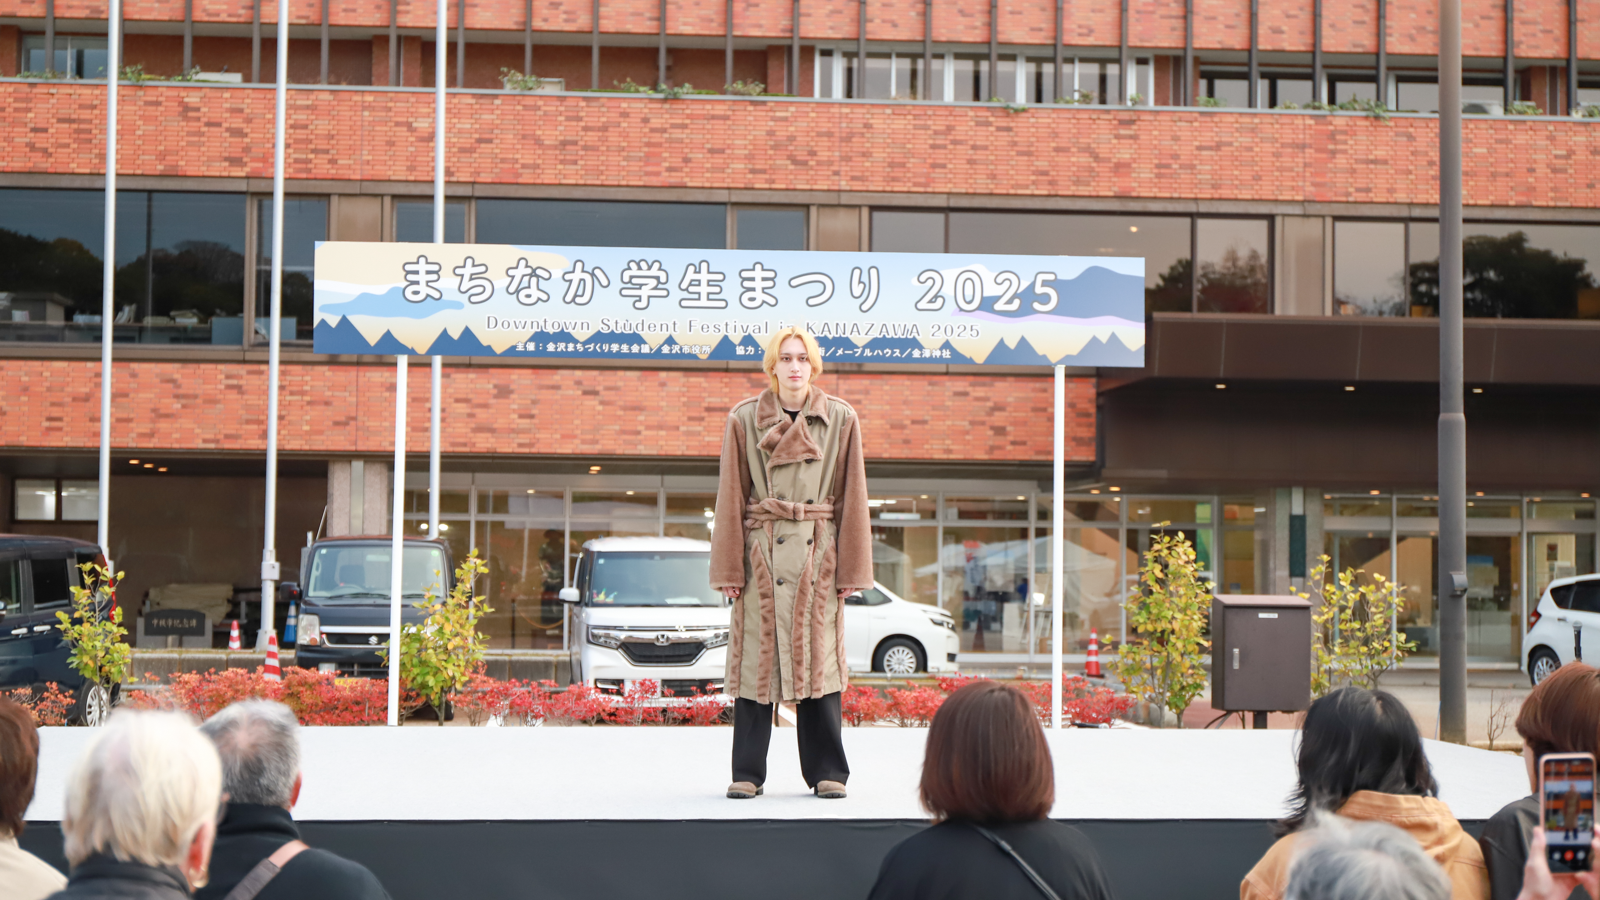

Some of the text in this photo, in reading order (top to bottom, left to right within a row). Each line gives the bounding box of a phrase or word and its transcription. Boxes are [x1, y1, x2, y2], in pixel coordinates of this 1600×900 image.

[402, 254, 1059, 313] まちなか学生まつり 2025
[486, 315, 590, 331] Downtown
[600, 317, 679, 333] Student
[688, 319, 769, 334] Festival
[806, 321, 921, 338] KANAZAWA
[931, 323, 981, 338] 2025
